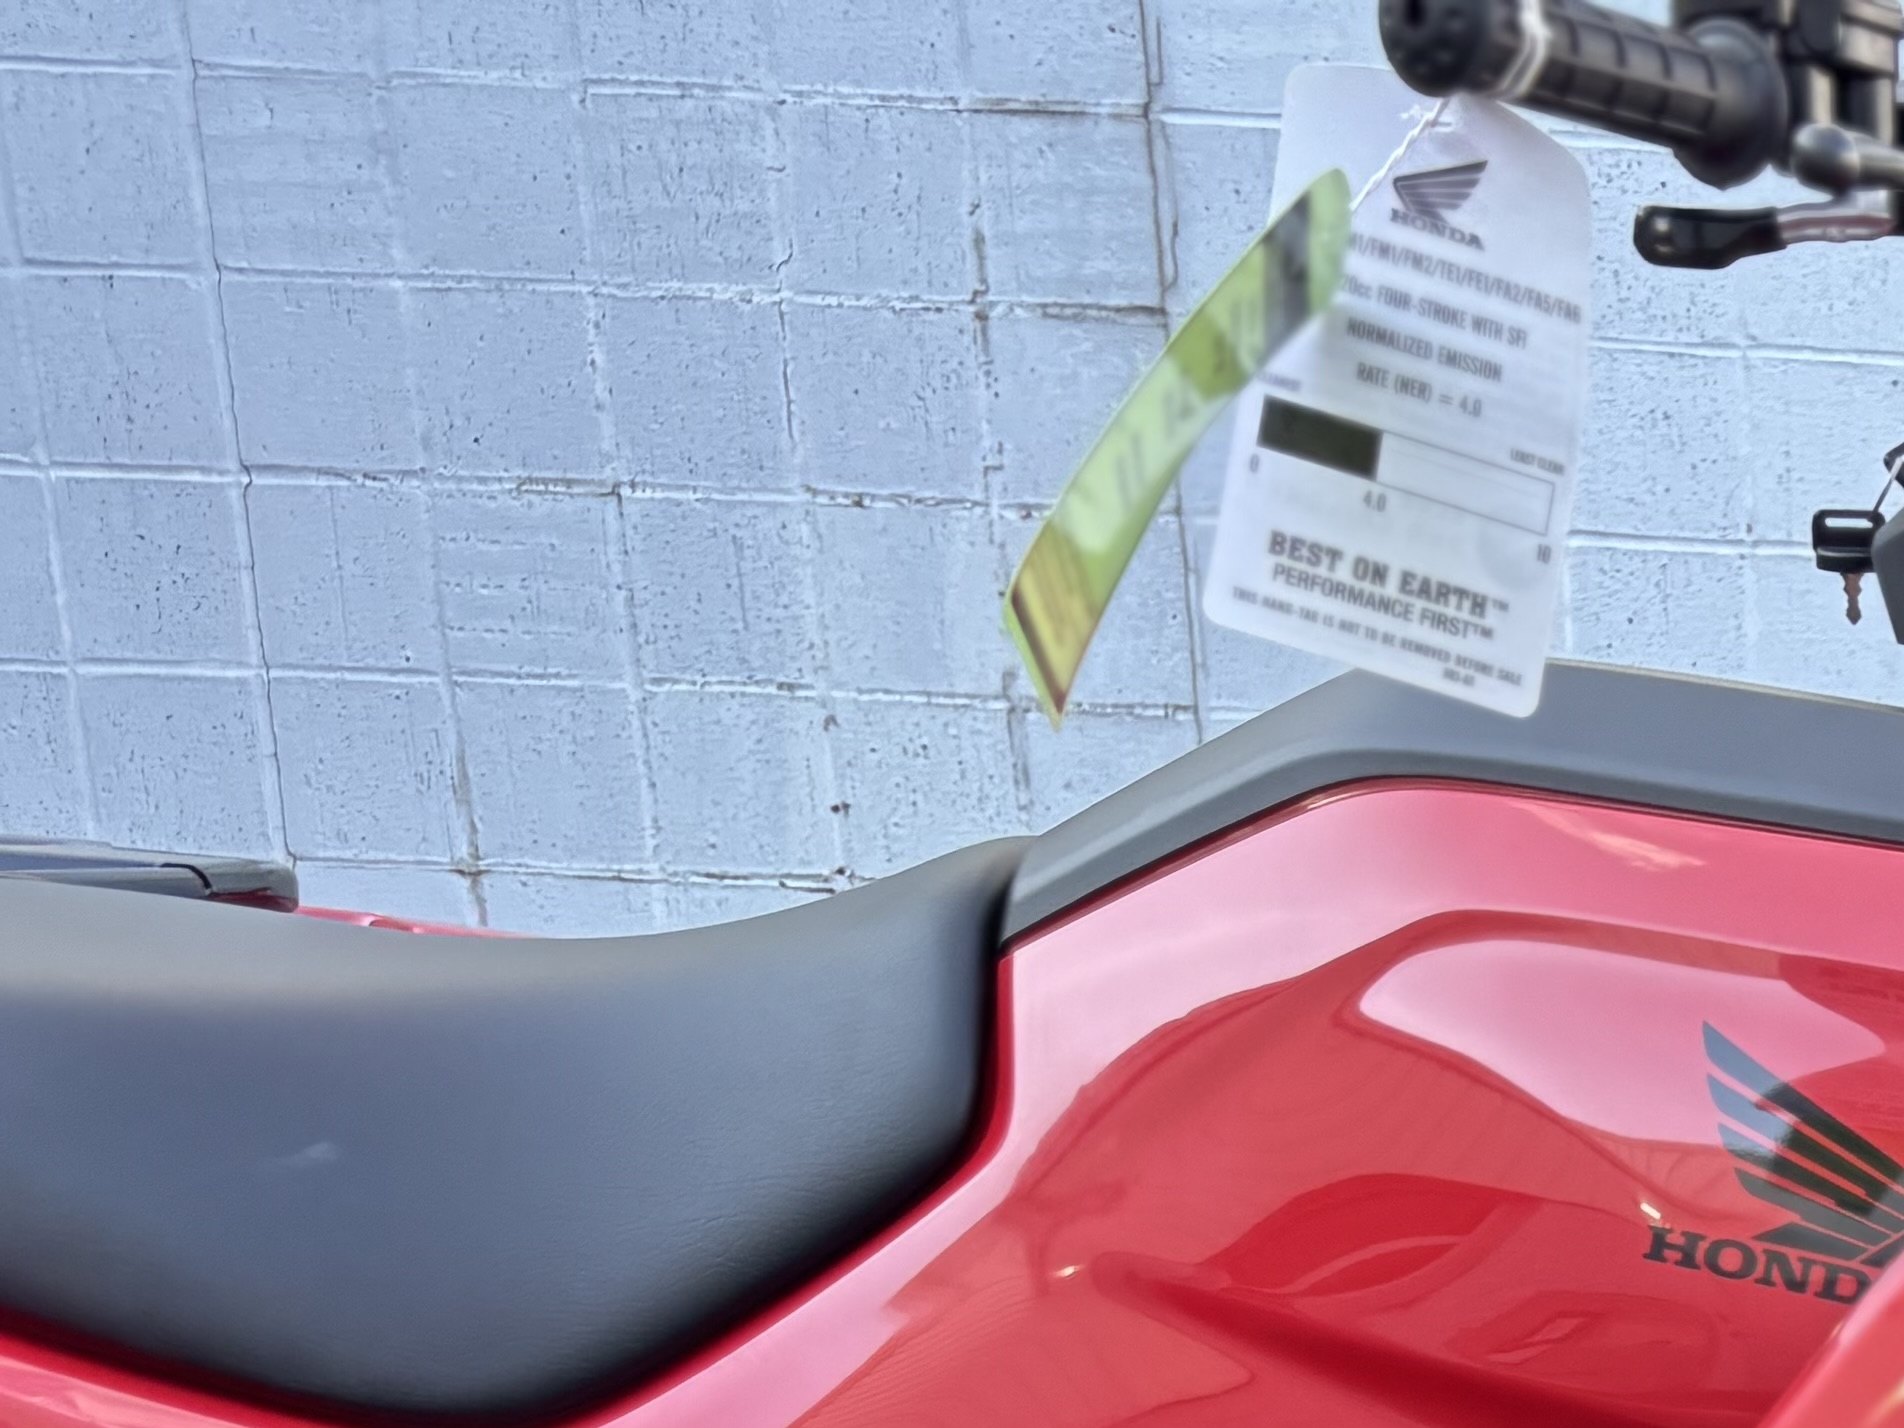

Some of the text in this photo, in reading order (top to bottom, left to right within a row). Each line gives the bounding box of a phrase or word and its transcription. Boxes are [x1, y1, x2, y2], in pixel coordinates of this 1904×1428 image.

[1390, 208, 1486, 251] HONDA
[1341, 274, 1373, 301] 20cc
[1377, 284, 1468, 330] FOUR-STROKE
[1471, 314, 1503, 340] WITH
[1347, 317, 1503, 382] NORMALIZED EMISSION
[1356, 362, 1389, 389] RATE
[1394, 373, 1433, 402] (NER)
[1459, 395, 1482, 418] 4.0
[1250, 454, 1260, 473] 0
[1363, 490, 1387, 512] 4.0
[1268, 529, 1343, 572] BEST
[1352, 555, 1390, 586] ON
[1537, 544, 1552, 565] 10
[1272, 563, 1415, 623] PERFORMANCE
[1642, 1224, 1872, 1305] HOND
